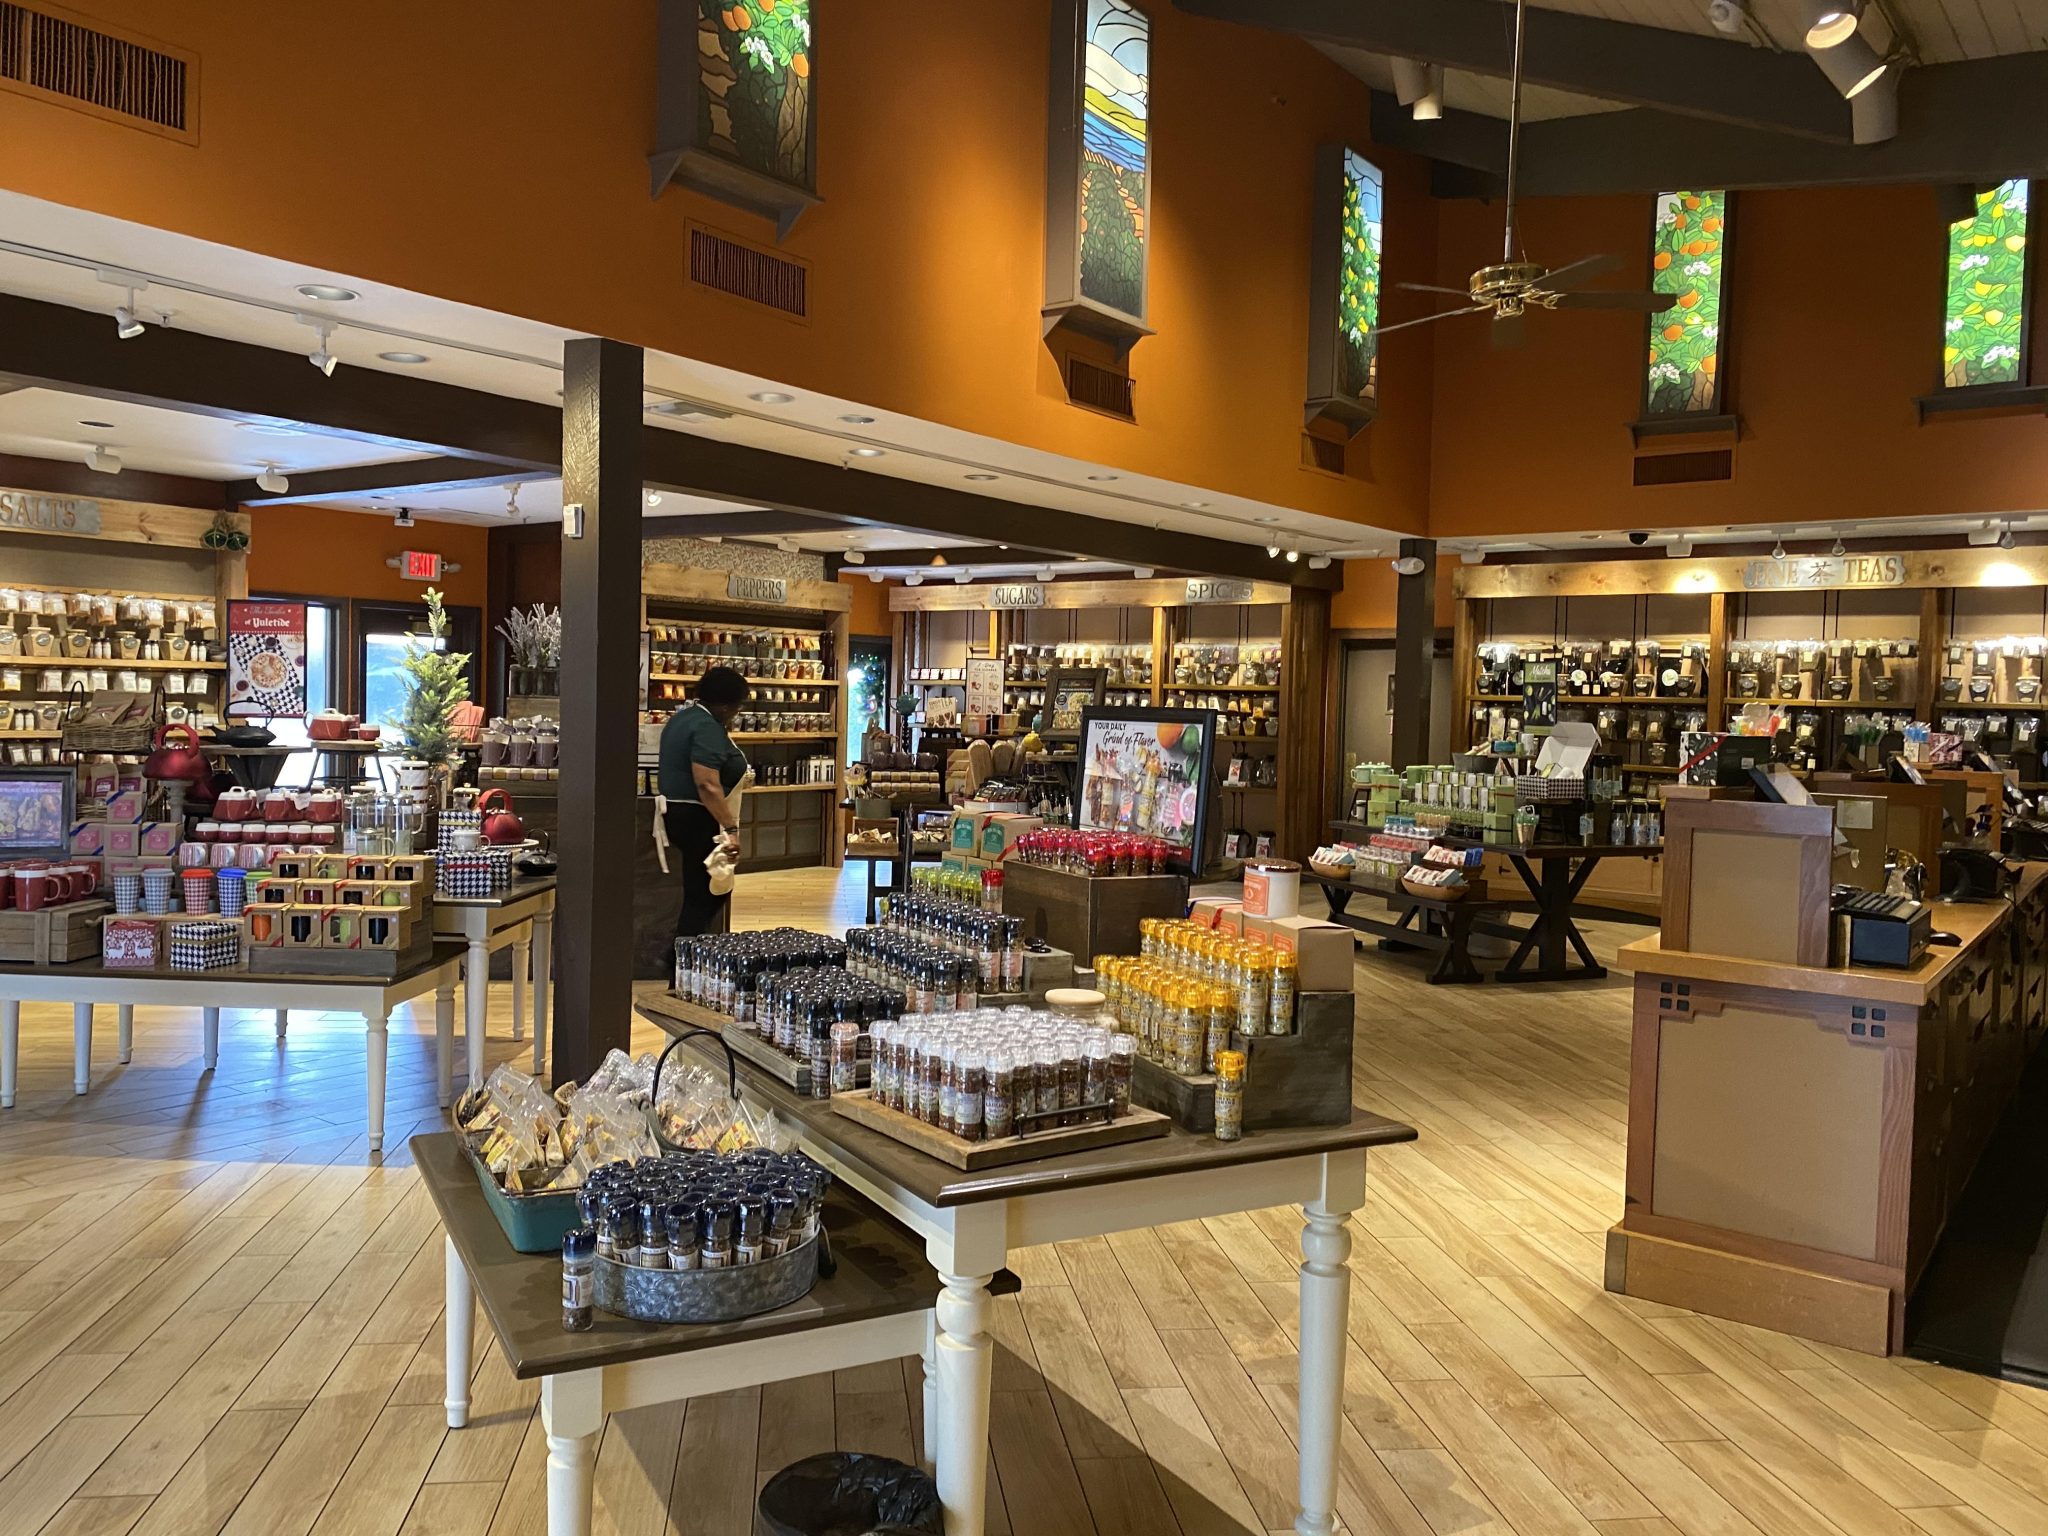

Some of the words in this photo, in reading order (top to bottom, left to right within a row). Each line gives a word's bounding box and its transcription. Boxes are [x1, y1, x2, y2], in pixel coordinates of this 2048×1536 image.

[0, 494, 76, 528] SALTS
[409, 551, 437, 577] EXIT
[1752, 561, 1799, 585] FINE
[1808, 561, 1835, 584] 茶
[1843, 558, 1897, 583] TEAS
[736, 577, 782, 600] PEPPERS
[995, 586, 1039, 605] SUGARS
[1188, 583, 1251, 599] SPICES
[253, 618, 290, 628] Yuletide
[1095, 722, 1110, 730] YOUR
[1111, 723, 1126, 731] DAILY
[1103, 731, 1123, 746] Grind
[1125, 735, 1133, 752] of
[1132, 732, 1156, 755] Flavor
